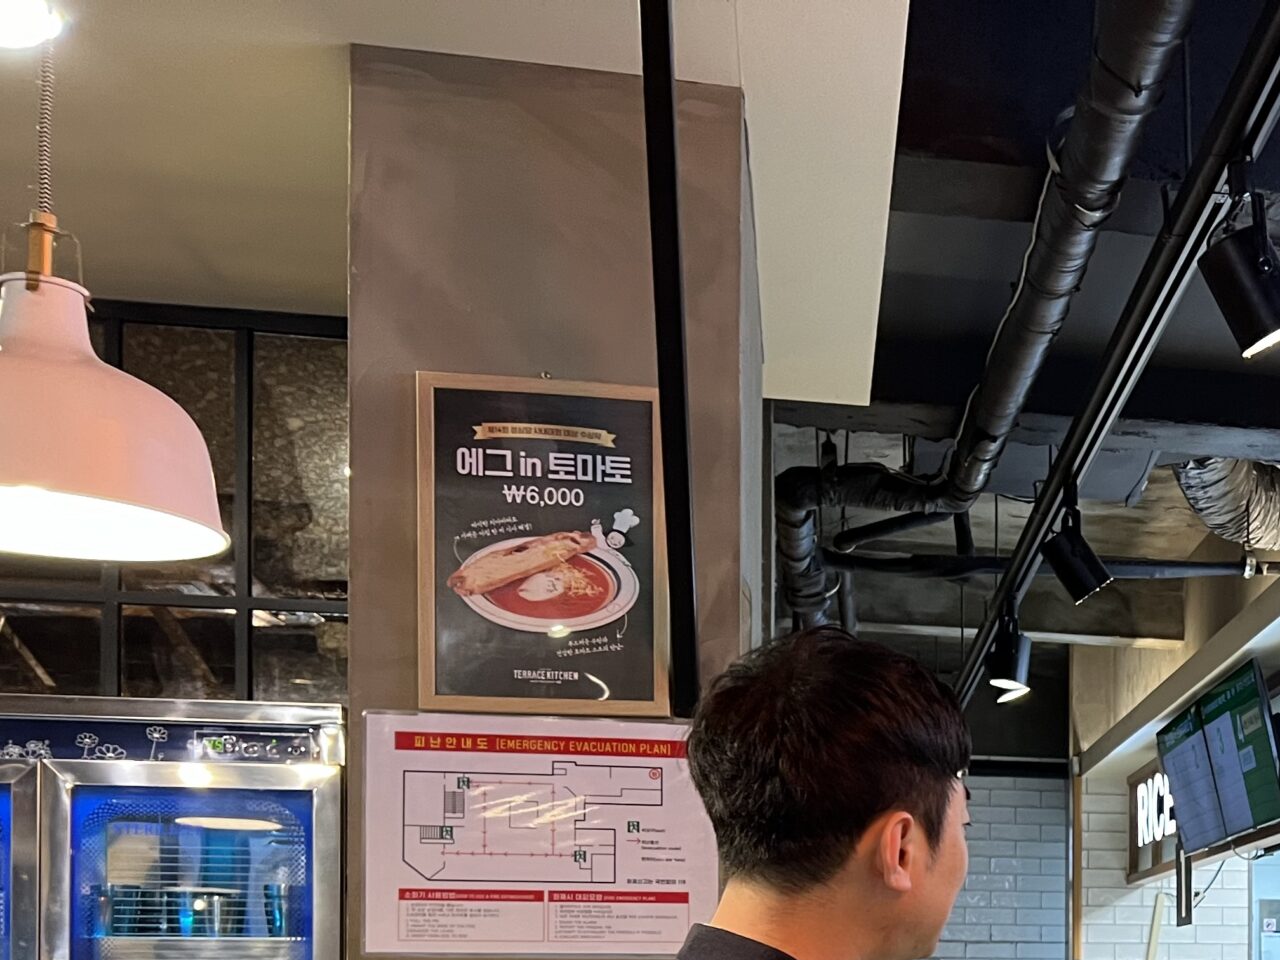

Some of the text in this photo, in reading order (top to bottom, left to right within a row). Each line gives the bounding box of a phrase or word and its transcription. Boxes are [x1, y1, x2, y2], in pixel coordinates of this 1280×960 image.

[456, 447, 632, 484] 에그 in 토마토
[502, 484, 585, 508] ₩6,000
[514, 669, 579, 681] TERRACE KITCHEN
[569, 740, 636, 754] EVACUATION
[1136, 772, 1177, 848] RICE
